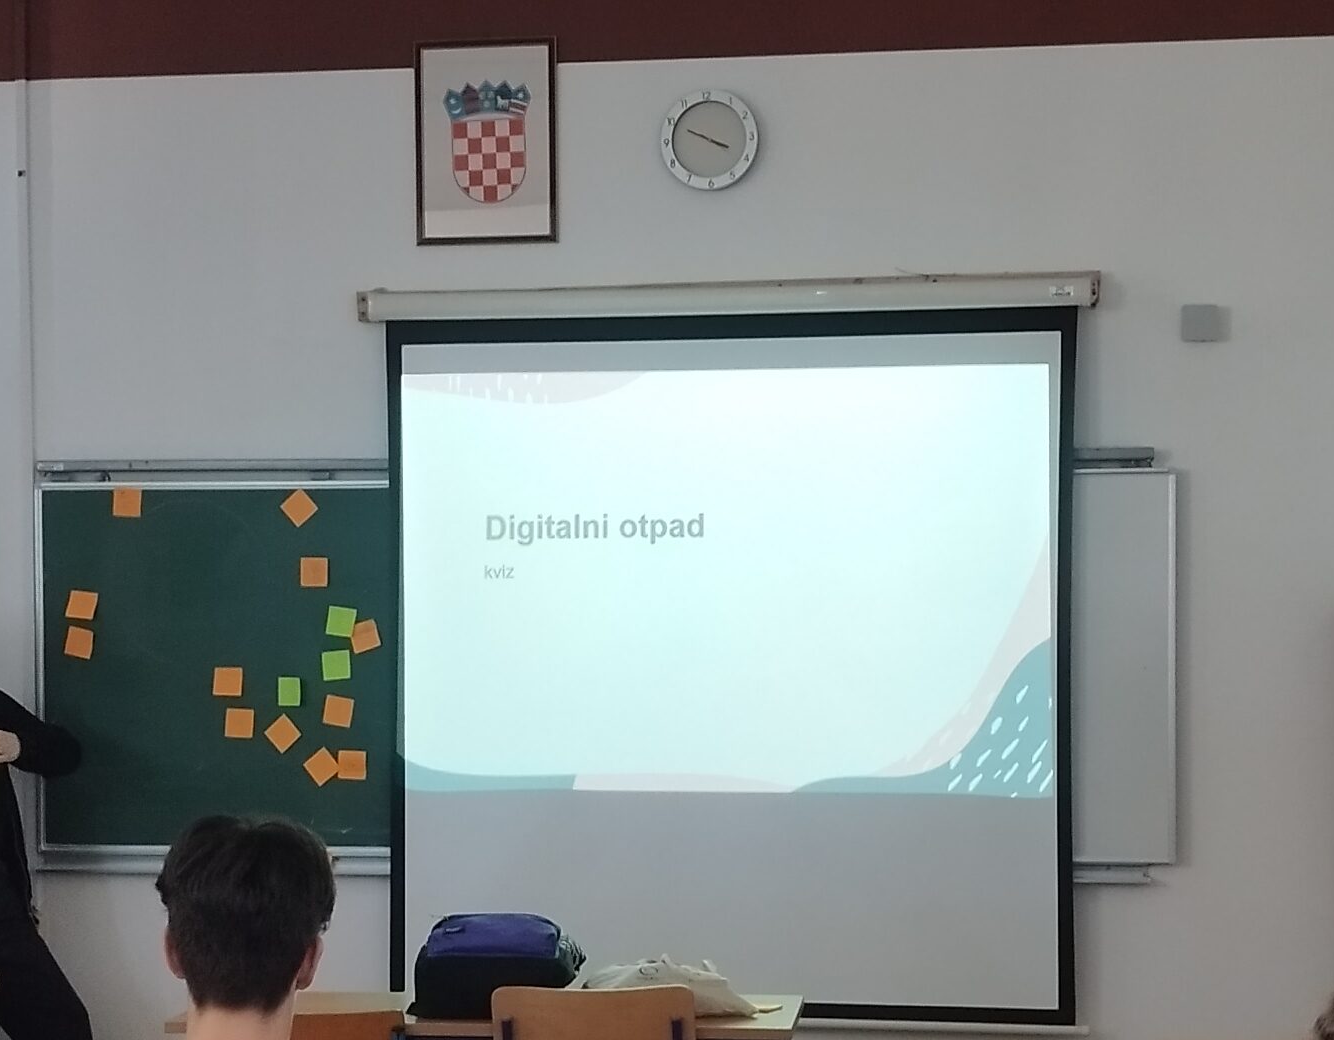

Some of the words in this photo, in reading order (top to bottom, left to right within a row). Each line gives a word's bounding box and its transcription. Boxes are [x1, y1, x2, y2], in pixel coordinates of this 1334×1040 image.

[701, 91, 711, 101] 12
[742, 111, 748, 120] 2
[749, 131, 755, 141] 3
[663, 138, 670, 148] 9
[708, 178, 715, 189] 6
[486, 514, 608, 546] Digitalni
[619, 513, 705, 545] otpad
[483, 565, 515, 580] kviz
